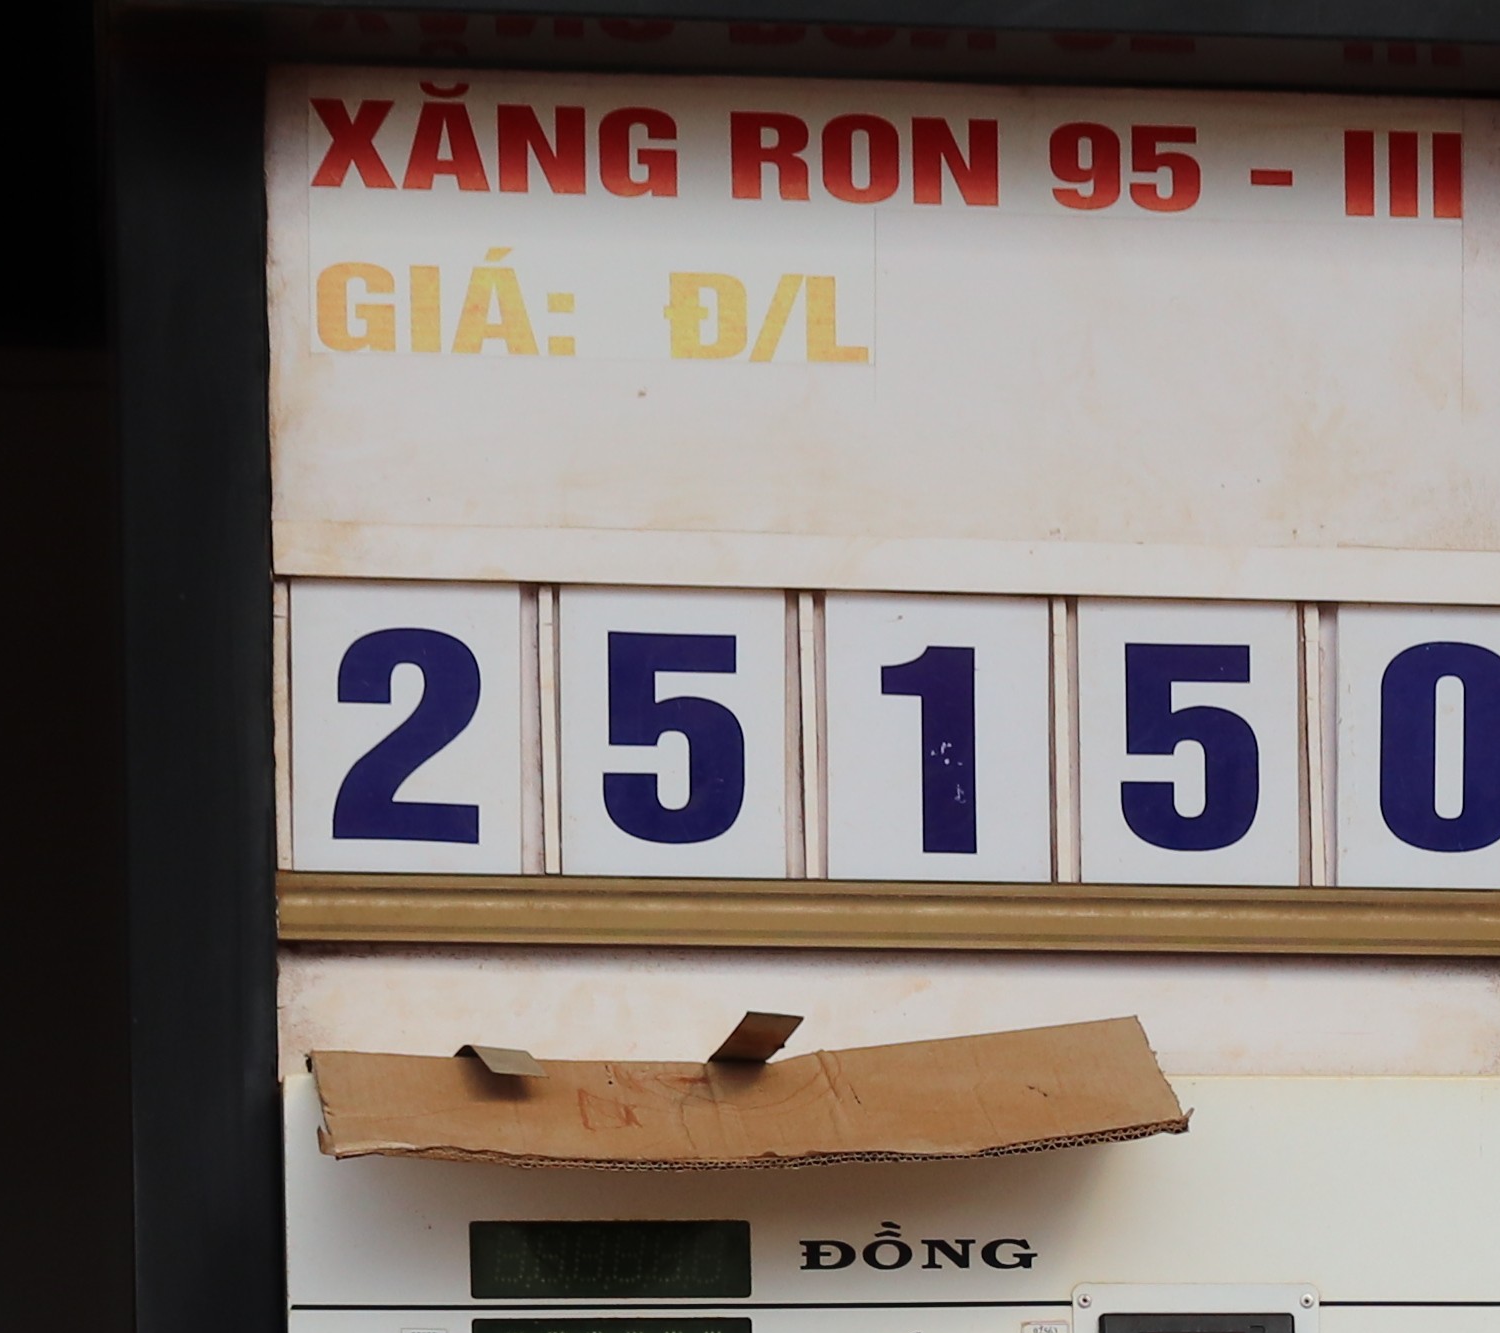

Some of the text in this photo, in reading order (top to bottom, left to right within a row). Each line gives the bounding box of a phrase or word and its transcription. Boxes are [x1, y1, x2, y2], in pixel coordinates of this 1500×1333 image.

[311, 83, 680, 199] XĂNG
[728, 111, 1000, 206] RON
[1048, 123, 1202, 212] 95
[1343, 130, 1464, 220] III
[314, 245, 870, 364] GIÁ: Đ/L
[798, 1222, 1040, 1272] ĐỒNG
